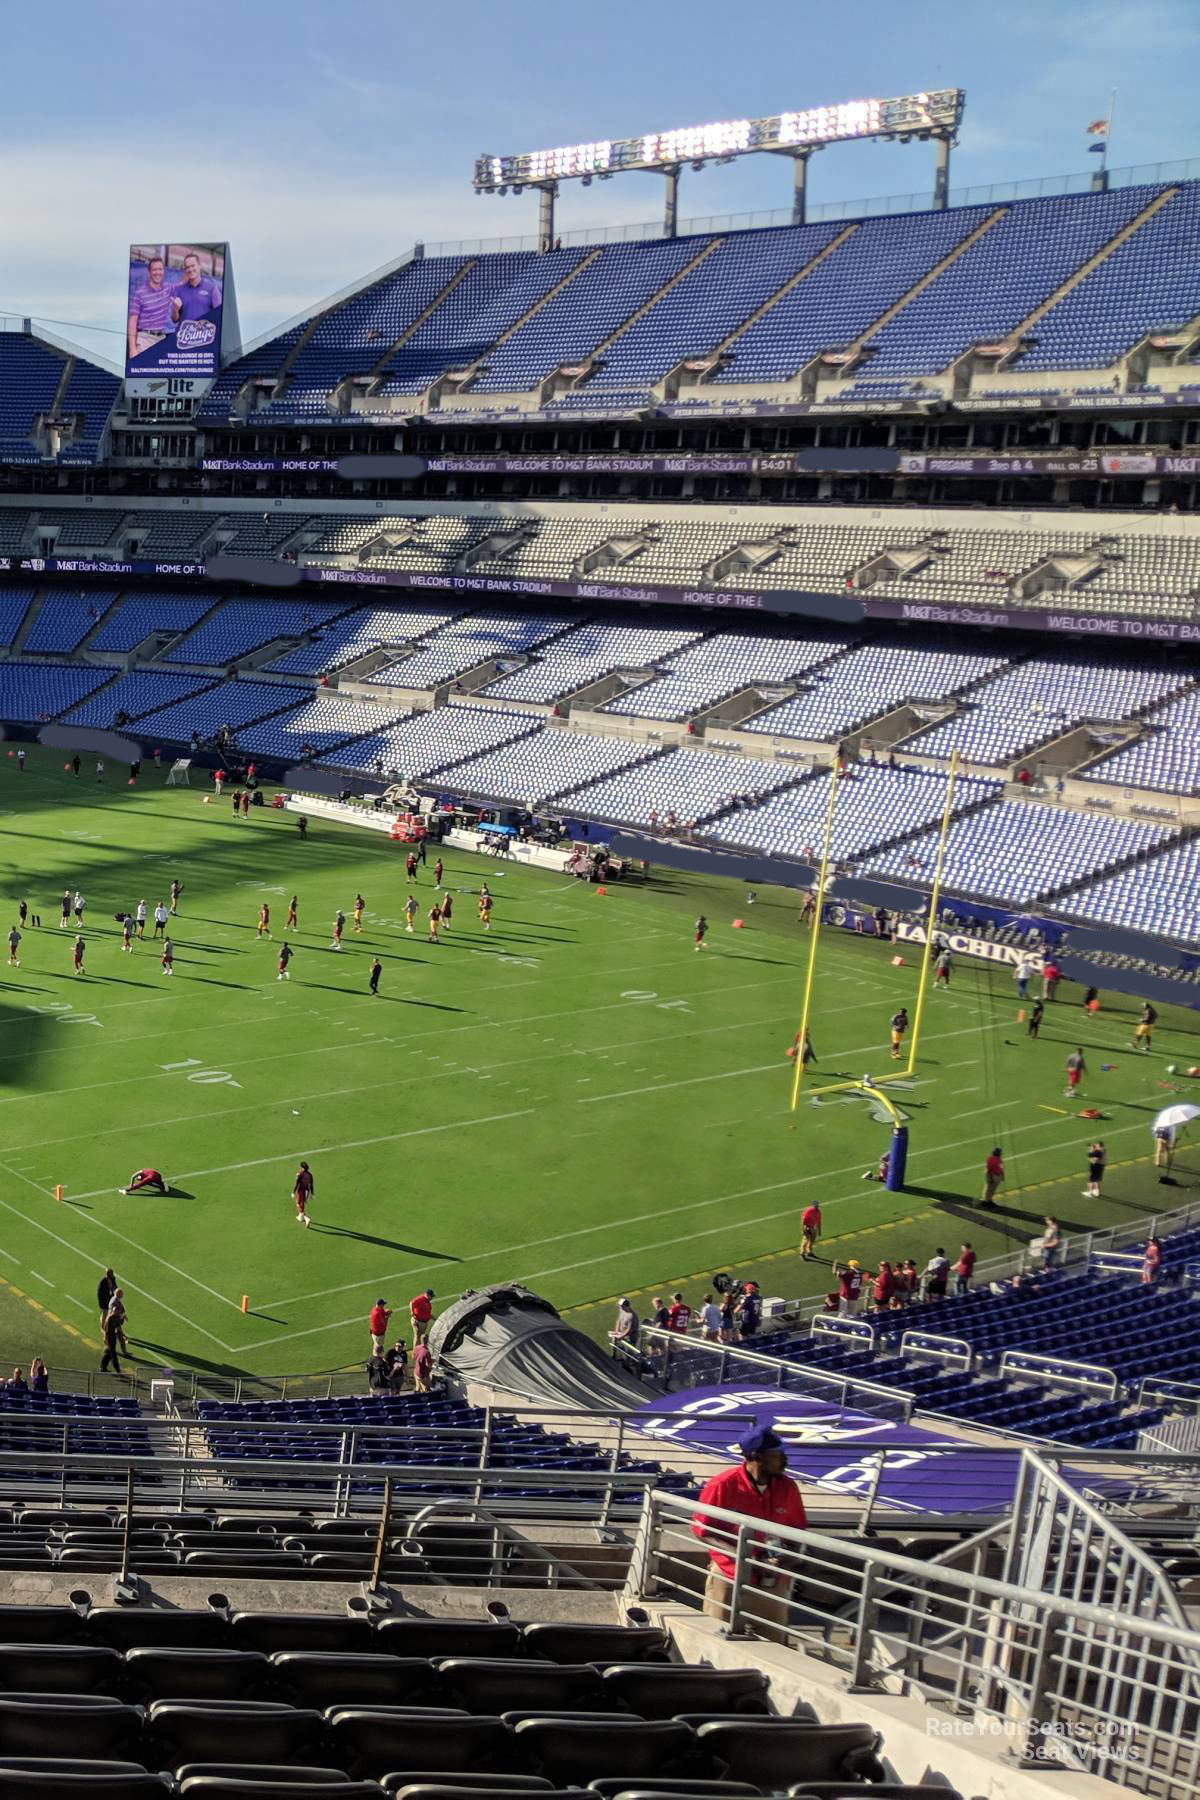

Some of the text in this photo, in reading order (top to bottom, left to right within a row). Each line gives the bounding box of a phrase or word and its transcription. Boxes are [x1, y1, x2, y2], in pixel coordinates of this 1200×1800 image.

[167, 378, 194, 397] Lite
[203, 460, 274, 470] M&T Bank Stadium
[282, 461, 339, 470] HOME OF THE
[427, 460, 496, 471] M&T Bank Stadium
[505, 460, 654, 470] WELCOME TO M&T BANK STADIUM
[664, 460, 747, 471] M&T Bank Stadium
[760, 461, 791, 470] 54:01
[1023, 460, 1033, 471] 4
[1081, 460, 1098, 471] 25
[1164, 458, 1199, 472] M&T
[56, 560, 132, 573] M&T Bank Stadium
[155, 564, 182, 574] HOME
[183, 565, 196, 575] OF
[320, 570, 387, 584] M&T Bank Stadium
[409, 575, 552, 593] WELCOME TO M&T BANK STADIUM
[576, 584, 658, 601] M&T Bank Stadium
[683, 591, 715, 604] HOME
[717, 593, 733, 605] OF
[734, 594, 756, 607] THE
[903, 605, 1009, 625] M&T Bank Stadium
[1047, 615, 1120, 633] WELCOME
[1122, 621, 1143, 634] TO
[1145, 623, 1178, 637] M&T
[155, 1058, 233, 1083] 10
